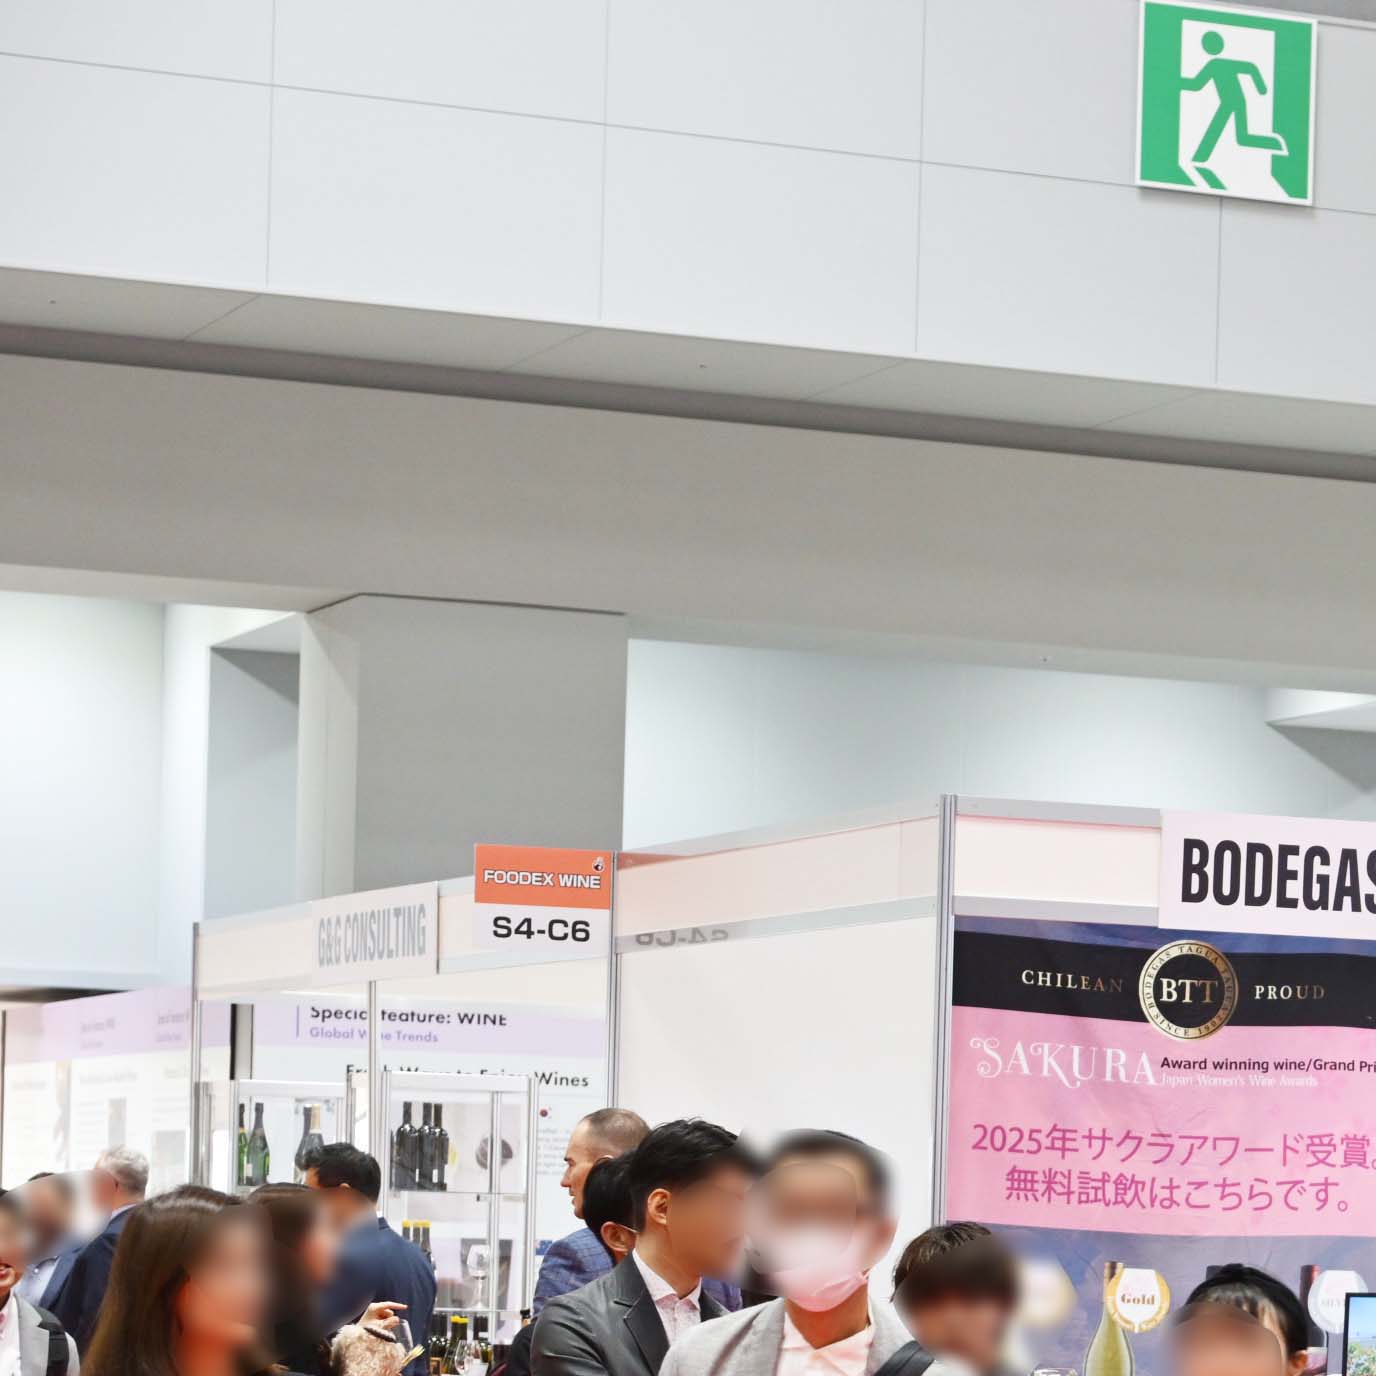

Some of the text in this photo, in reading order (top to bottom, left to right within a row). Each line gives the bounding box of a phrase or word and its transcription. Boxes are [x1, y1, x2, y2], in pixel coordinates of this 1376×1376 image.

[483, 869, 601, 889] FOODEX WINE
[318, 903, 427, 968] G&G CONSULTING
[492, 915, 591, 943] S4-C6
[1021, 968, 1124, 994] CHILEAN
[1160, 977, 1218, 1004] BTT
[1253, 982, 1326, 1001] PROUD
[309, 1026, 354, 1040] Global
[396, 1029, 439, 1043] Trends
[969, 1038, 1161, 1089] SAKURA
[1160, 1057, 1208, 1071] Award
[1212, 1058, 1270, 1073] winning
[1273, 1058, 1356, 1072] wine/Grand
[535, 1071, 589, 1088] Wines
[1004, 1165, 1350, 1214] 無料試飲はこちらです。
[1121, 1293, 1156, 1306] Gold
